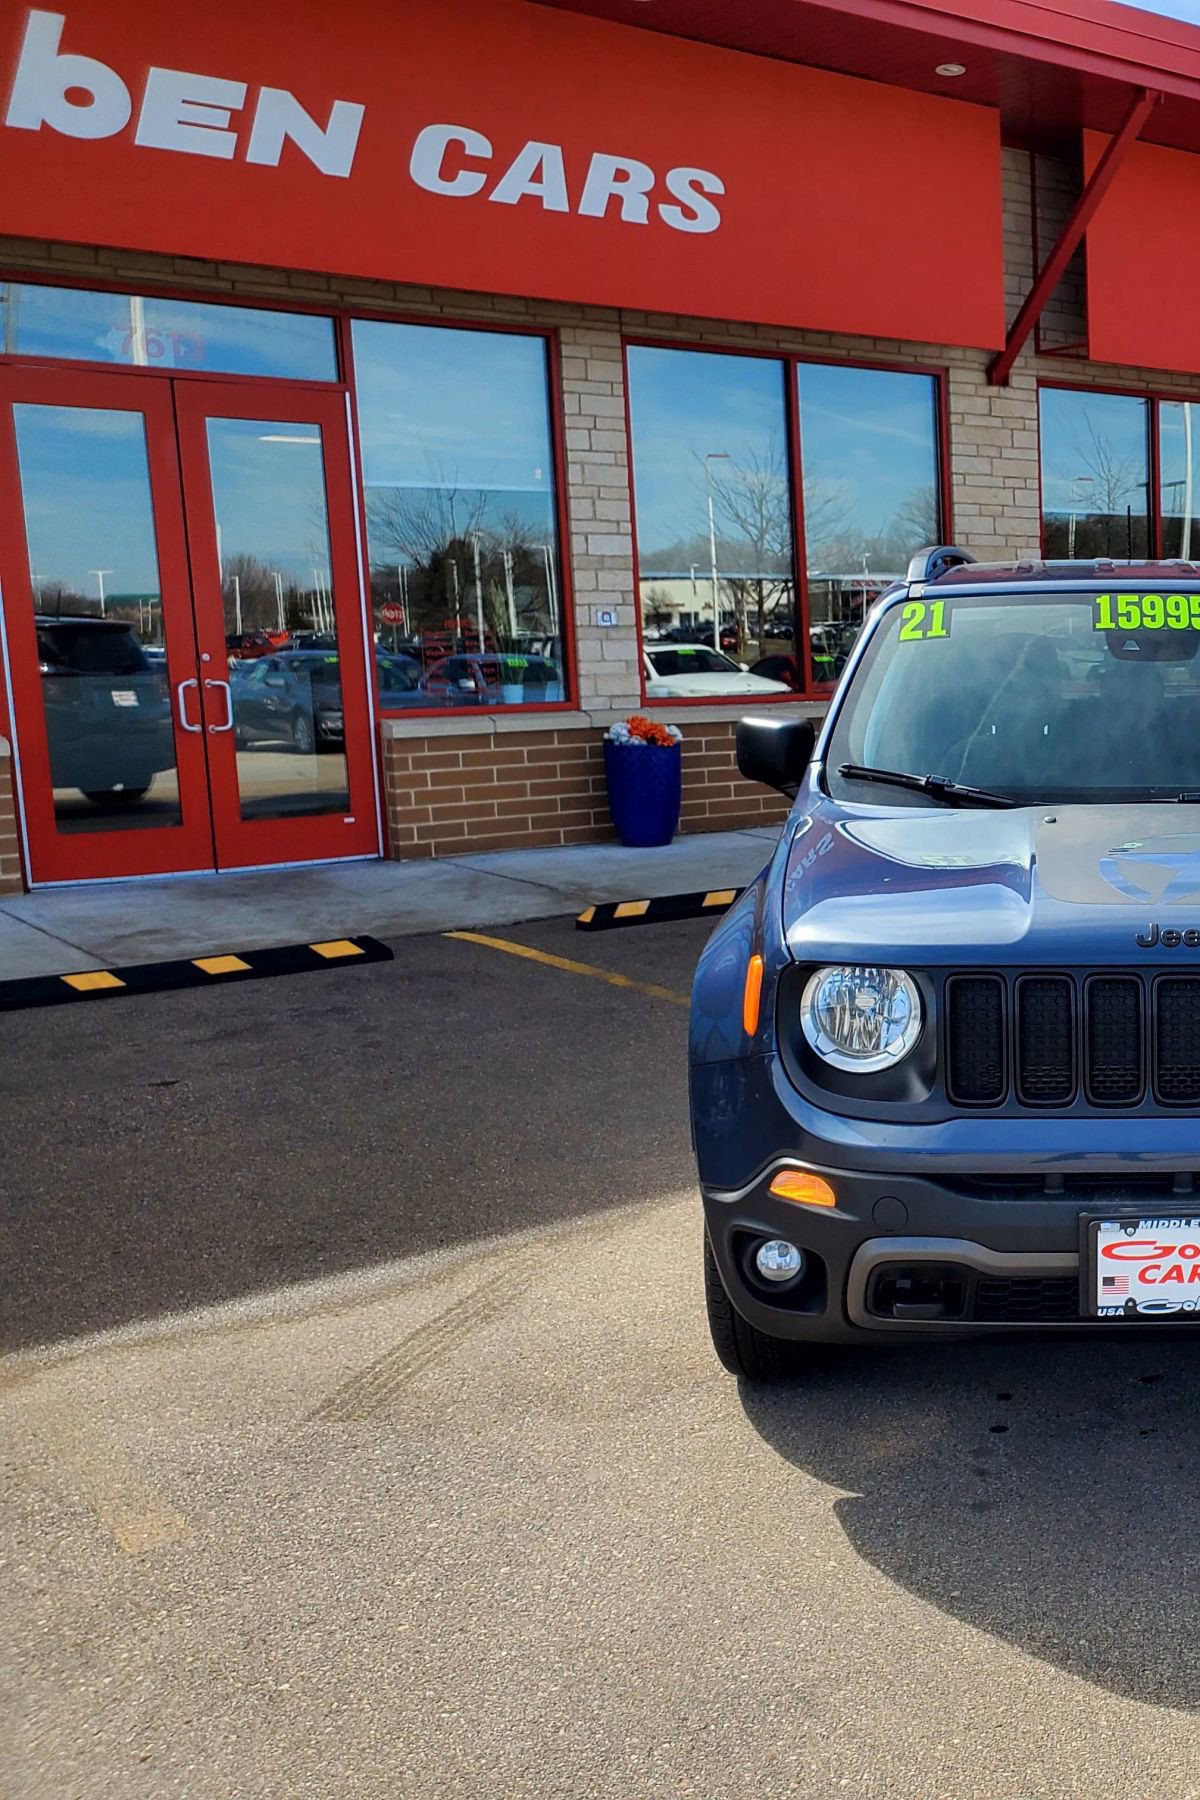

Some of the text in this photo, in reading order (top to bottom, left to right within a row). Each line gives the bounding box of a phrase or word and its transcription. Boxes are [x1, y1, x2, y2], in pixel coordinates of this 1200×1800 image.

[409, 123, 726, 235] CARS
[900, 601, 947, 640] 21
[1097, 1306, 1125, 1317] USA
